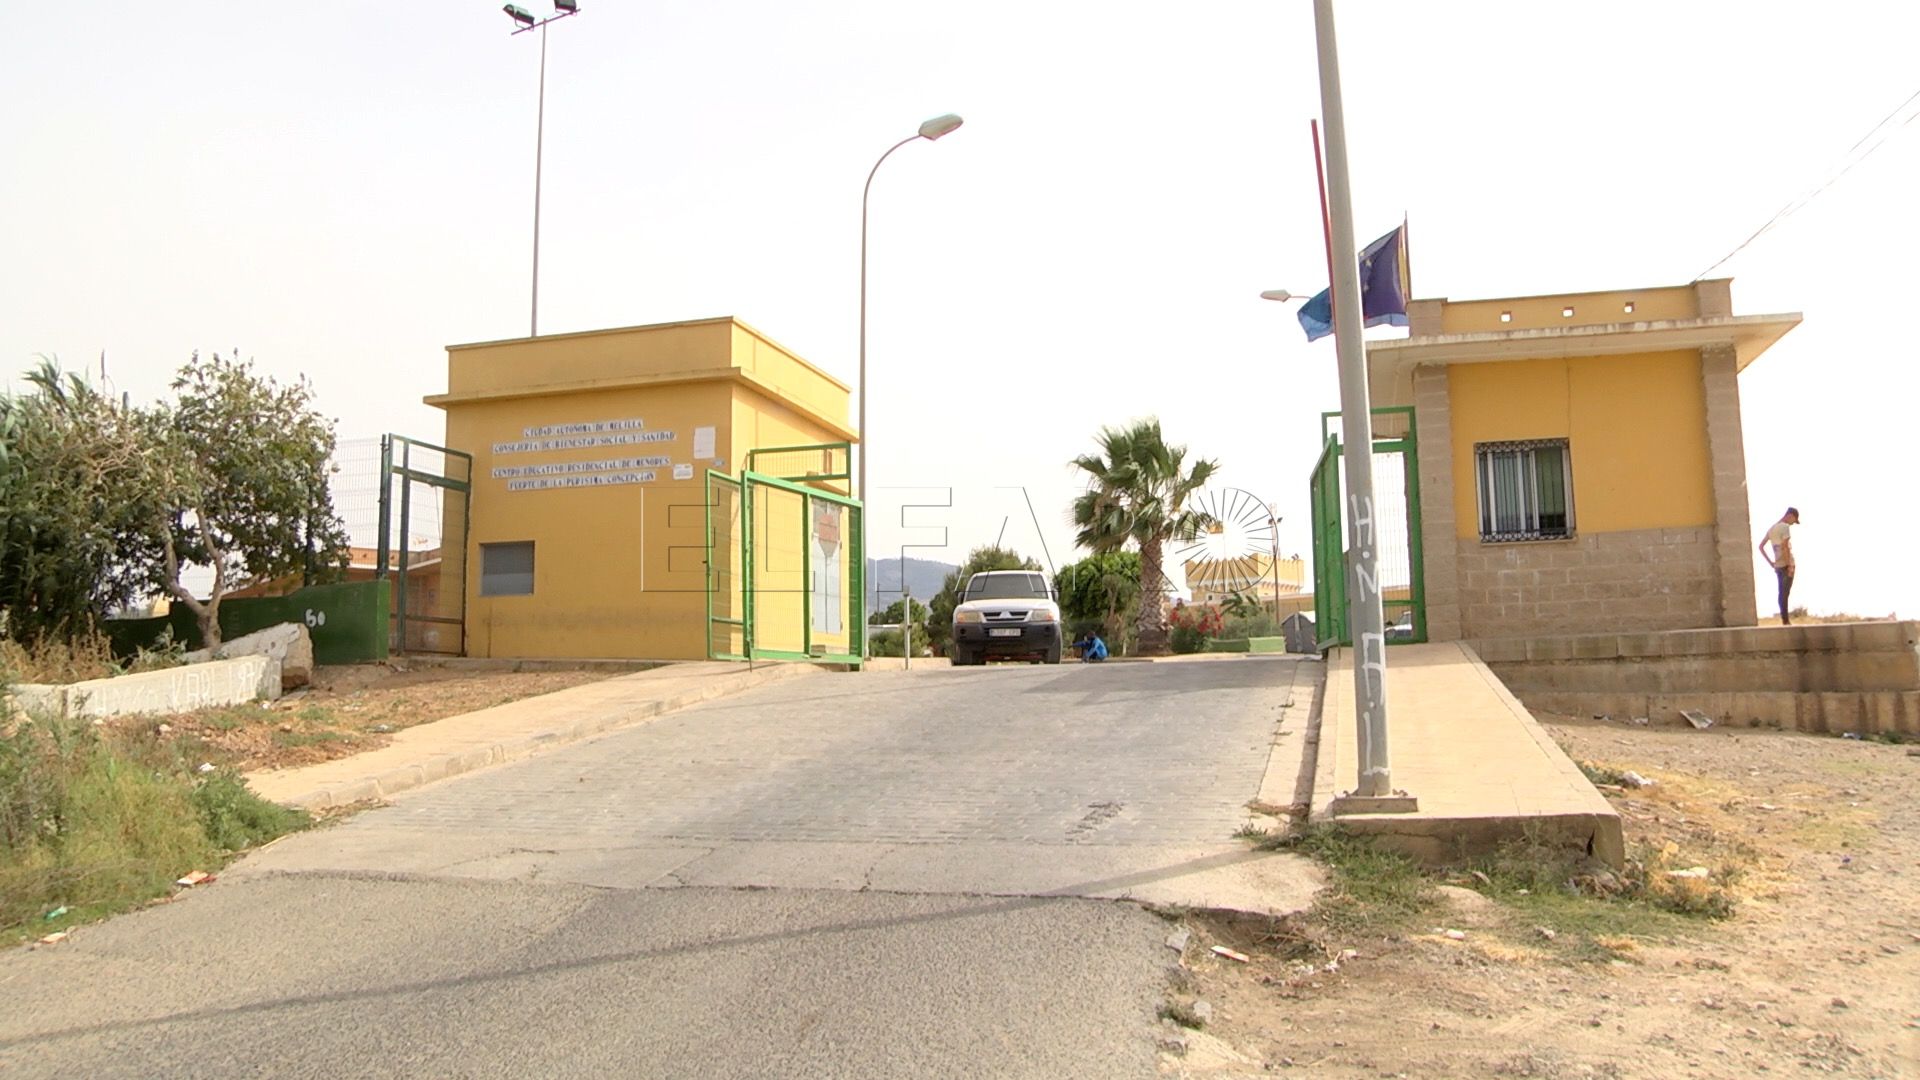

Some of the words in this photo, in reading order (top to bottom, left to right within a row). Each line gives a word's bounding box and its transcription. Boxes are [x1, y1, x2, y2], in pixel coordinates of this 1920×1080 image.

[525, 427, 552, 437] CIUDAD
[595, 423, 604, 431] DE
[609, 420, 642, 430] MELILLA
[542, 441, 551, 449] DE
[555, 438, 595, 447] BIENESTAR
[600, 435, 626, 444] SOCIAL
[642, 431, 675, 441] SANIDAD
[493, 468, 520, 477] CENTRO
[523, 465, 564, 475] EDUCATIVO
[567, 461, 616, 471] RESIDENCIAL
[621, 460, 630, 468] DE
[636, 457, 670, 466] MENORES
[510, 479, 536, 490] FUERTE
[540, 479, 549, 487] DE
[553, 478, 562, 486] LA
